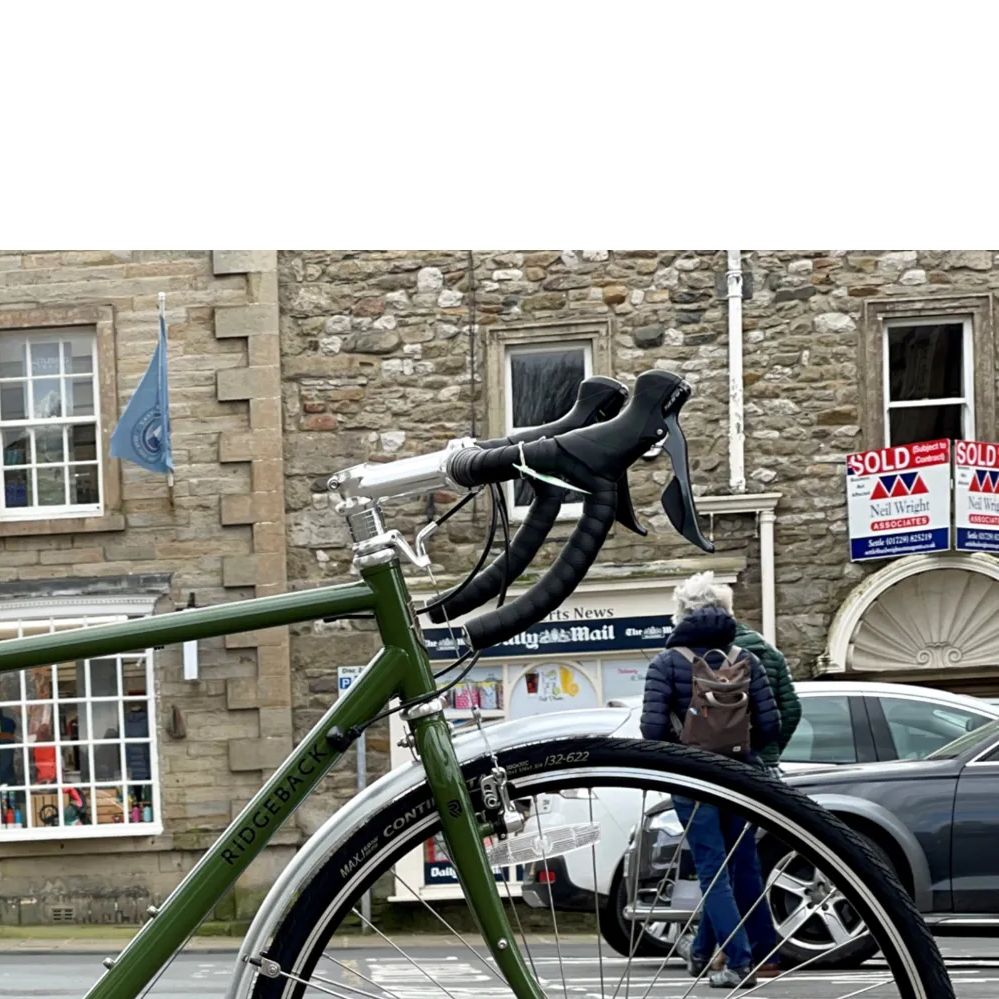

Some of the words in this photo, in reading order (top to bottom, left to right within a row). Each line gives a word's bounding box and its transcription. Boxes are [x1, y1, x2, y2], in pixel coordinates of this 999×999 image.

[939, 442, 947, 450] to
[956, 442, 996, 466] SOLD
[850, 447, 910, 477] SOLD
[869, 502, 892, 518] Neil
[894, 498, 931, 515] Wright
[967, 495, 982, 511] Neil
[873, 517, 928, 531] ASSOCIATES
[868, 537, 885, 548] Settle
[573, 605, 615, 620] News
[569, 624, 616, 643] Mail
[625, 626, 643, 637] The
[221, 744, 328, 866] RIDGEBACK
